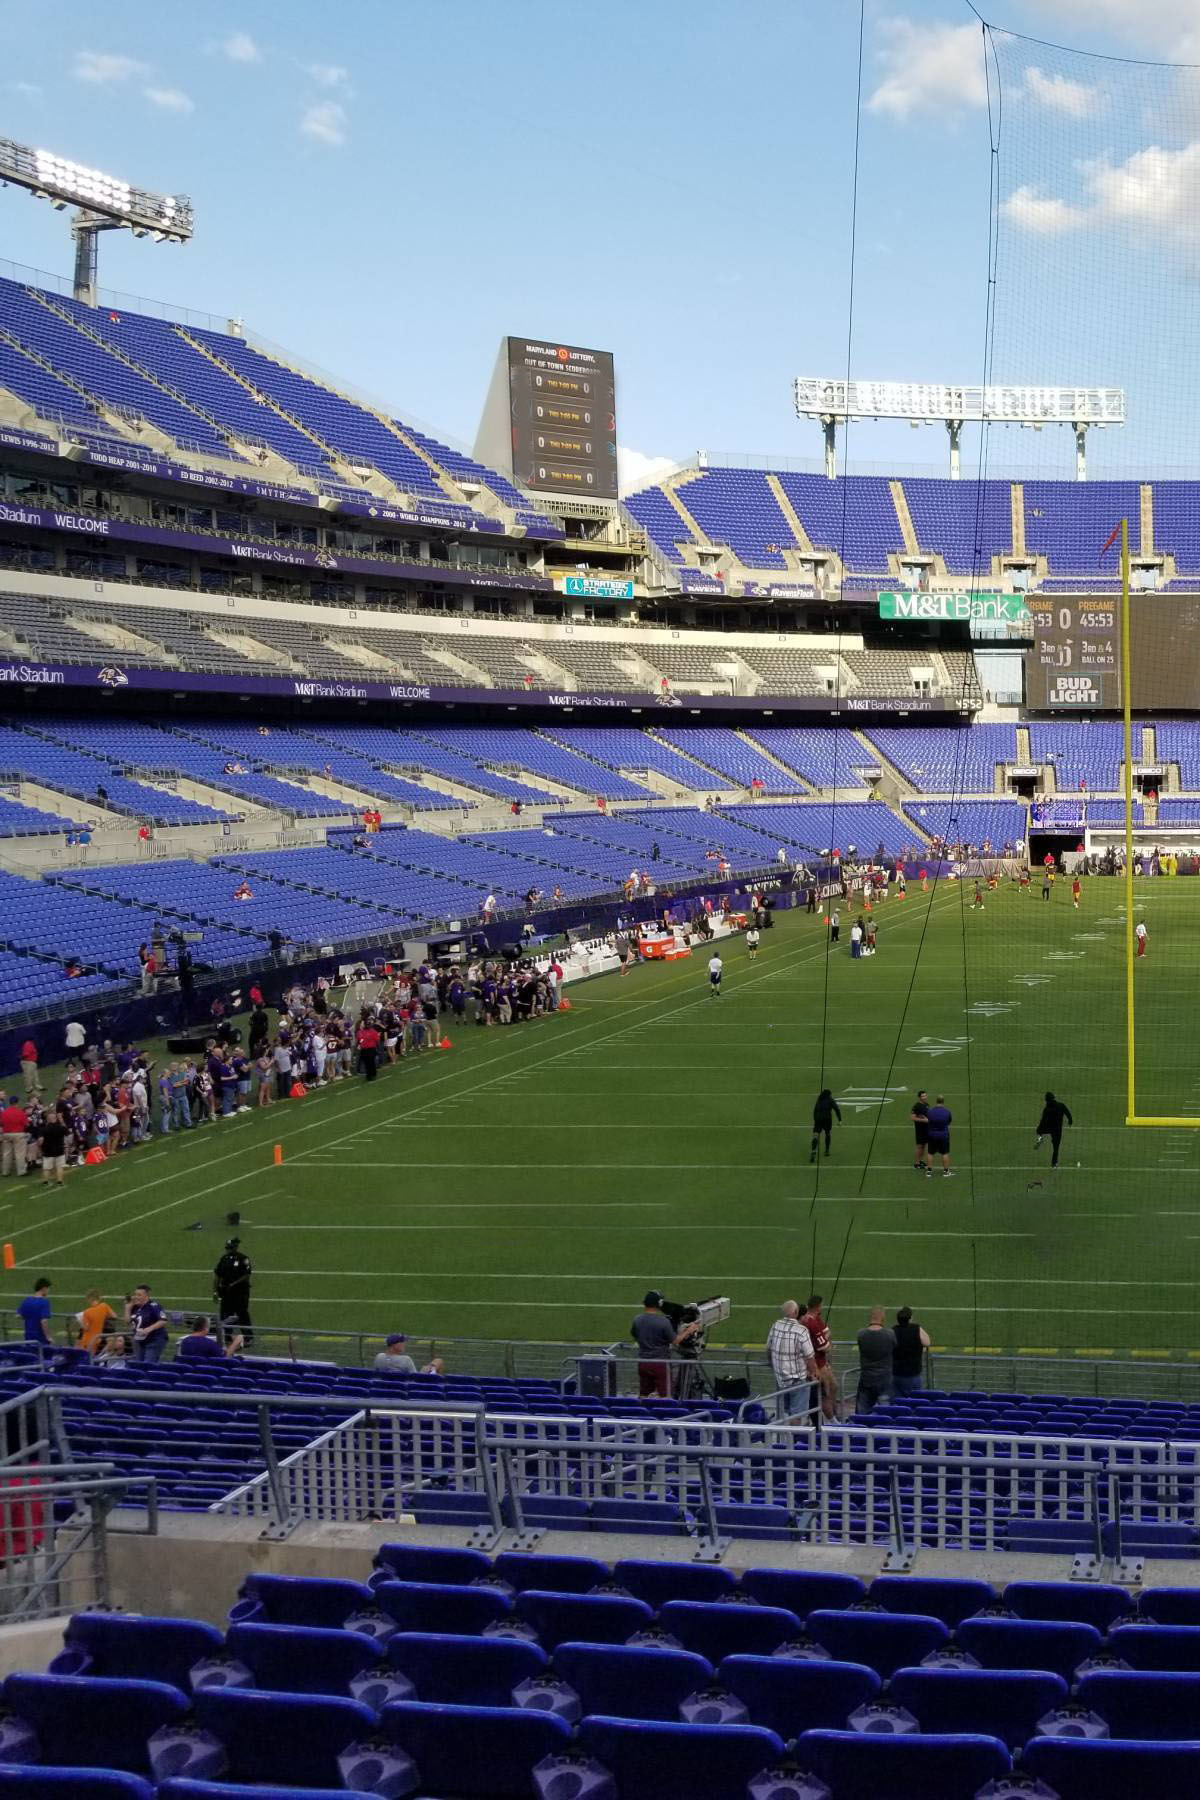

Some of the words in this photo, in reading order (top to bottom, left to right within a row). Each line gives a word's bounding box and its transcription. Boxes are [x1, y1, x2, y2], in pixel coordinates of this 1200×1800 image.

[526, 345, 557, 356] MARYLAND
[524, 358, 536, 366] OUT
[546, 361, 564, 371] TOWN
[536, 375, 542, 387] 0
[584, 382, 590, 394] 0
[537, 406, 544, 417] 0
[584, 412, 590, 424] 0
[1, 433, 21, 445] LEWIS
[22, 439, 55, 452] 1996-2012
[538, 436, 544, 448] 0
[586, 442, 592, 454] 0
[90, 452, 107, 463] TODD
[108, 456, 125, 466] HEAP
[181, 471, 188, 479] ED
[190, 474, 204, 482] REED
[204, 475, 234, 488] 2002-2012
[540, 468, 546, 478] 0
[586, 473, 592, 484] 0
[0, 505, 41, 525] Stadium
[54, 514, 109, 534] WELCOME
[382, 511, 396, 519] 2000
[400, 512, 419, 522] WORLD
[420, 515, 450, 526] CHAMPIONS
[231, 545, 252, 558] M&T
[583, 580, 628, 588] STRATEGIC
[584, 588, 628, 596] FACTORY
[894, 594, 954, 618] M&T
[956, 595, 1010, 618] Bank
[1078, 601, 1115, 611] PREGAME
[1059, 608, 1072, 630] 0
[1080, 613, 1114, 627] 45:53
[1105, 641, 1112, 653] 4
[1082, 656, 1096, 664] BALL
[1097, 656, 1106, 664] ON
[20, 666, 64, 684] Stadium
[294, 682, 316, 696] M&T
[336, 684, 366, 698] Stadium
[390, 686, 430, 698] WELCOME
[1056, 677, 1092, 690] BUD
[549, 696, 571, 705] M&T
[1050, 690, 1098, 702] LIGHT
[848, 700, 870, 710] M&T
[872, 700, 892, 710] Bank
[894, 700, 931, 710] Stadium
